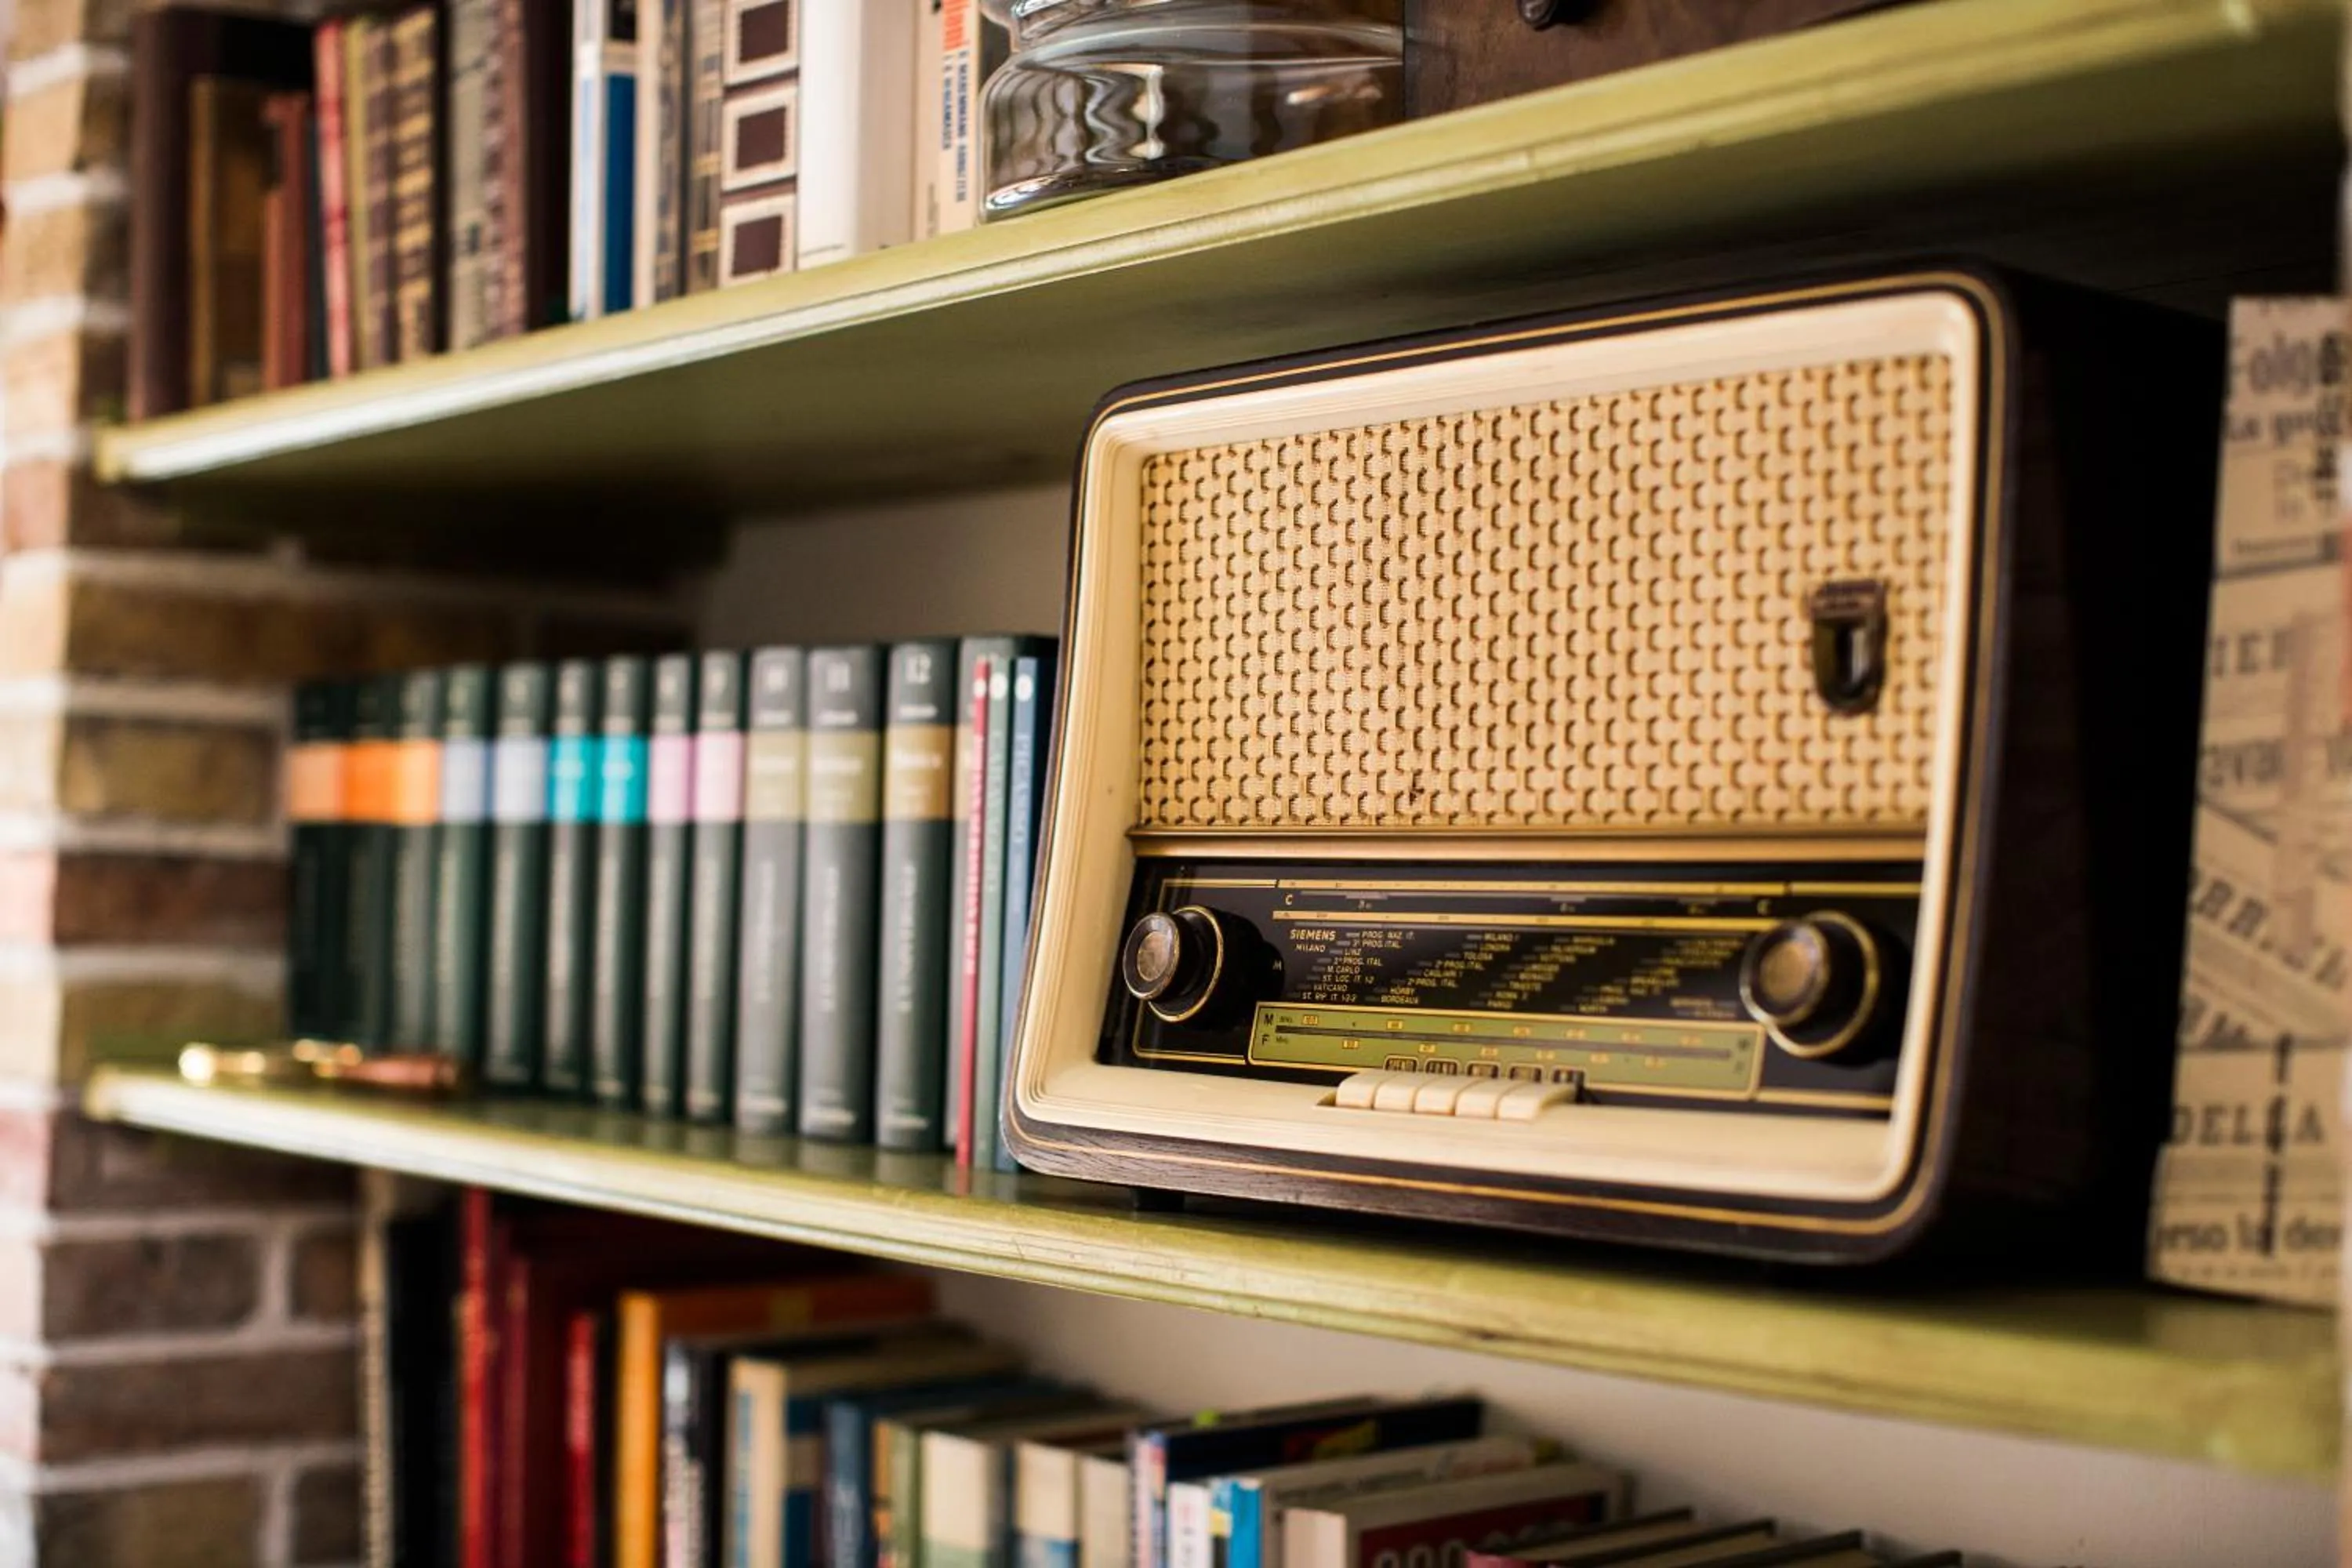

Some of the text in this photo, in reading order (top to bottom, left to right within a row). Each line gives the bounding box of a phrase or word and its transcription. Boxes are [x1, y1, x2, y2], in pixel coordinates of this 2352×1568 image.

[905, 652, 931, 684] 12
[1014, 732, 1031, 843] PICASSO
[1290, 930, 1336, 940] SIEMENS
[1296, 943, 1326, 953] MILANO
[1335, 965, 1360, 974] CARLO
[1381, 995, 1420, 1004] BORDEAUX
[1264, 1013, 1274, 1025] M
[1261, 1034, 1269, 1046] F
